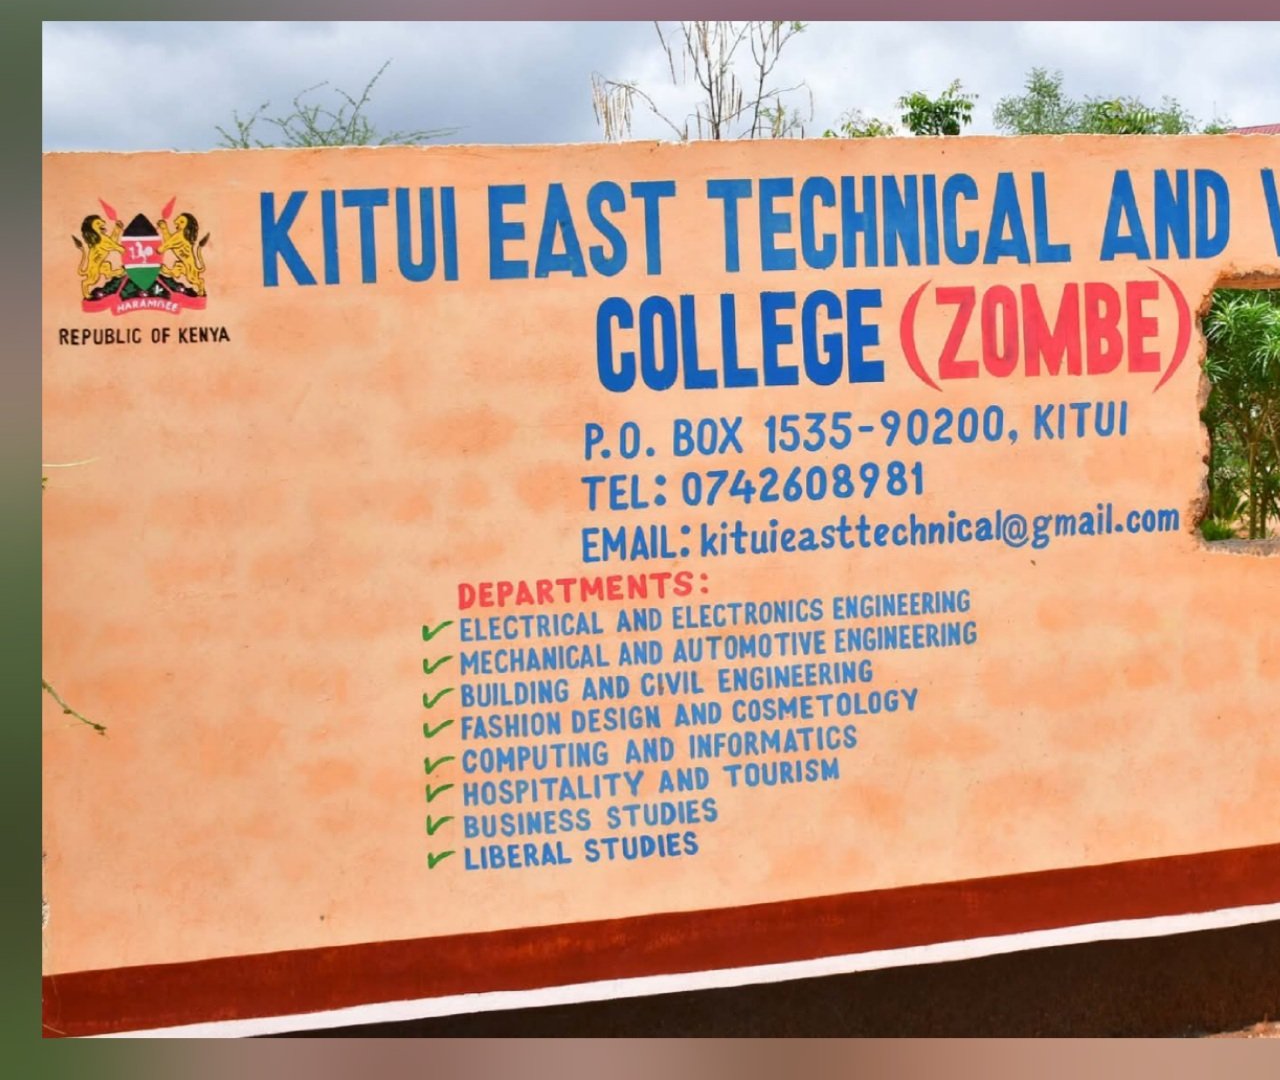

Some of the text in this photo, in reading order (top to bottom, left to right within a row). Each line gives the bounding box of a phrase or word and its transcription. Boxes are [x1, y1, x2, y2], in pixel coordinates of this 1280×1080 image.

[260, 186, 459, 287] KITUI
[487, 180, 677, 280] EAST
[706, 171, 1072, 273] TECHNICAL
[1100, 168, 1231, 261] AND
[59, 326, 230, 345] REPUBLIC OF KENYA
[596, 266, 1193, 394] COLLEGE (ZOMBE)
[584, 401, 1128, 459] P.O. BOX 1535-90200, KITUI
[582, 460, 924, 511] TEL: 0742608981
[581, 503, 1180, 563] EMAIL: kituieasttechnical@gmail.com
[458, 571, 708, 611] DEPARTMENTS:
[460, 589, 970, 642] ELECTRICAL AND ELECTRONICS ENGINEERING
[460, 621, 977, 675] MECHANICAL AND AUTOMOTIVE ENGINEERING
[461, 659, 873, 708] BUILDING AND CIVIL ENGINEERING
[461, 689, 917, 739] FASHION DESIGN AND COSMETOLOGY
[462, 725, 857, 774] COMPUTING AND INFORMATICS
[463, 759, 840, 805] HOSPITALITY AND TOURISM
[463, 797, 718, 839] BUSINESS STUDIES
[464, 831, 699, 871] LIBERAL STUDIES
